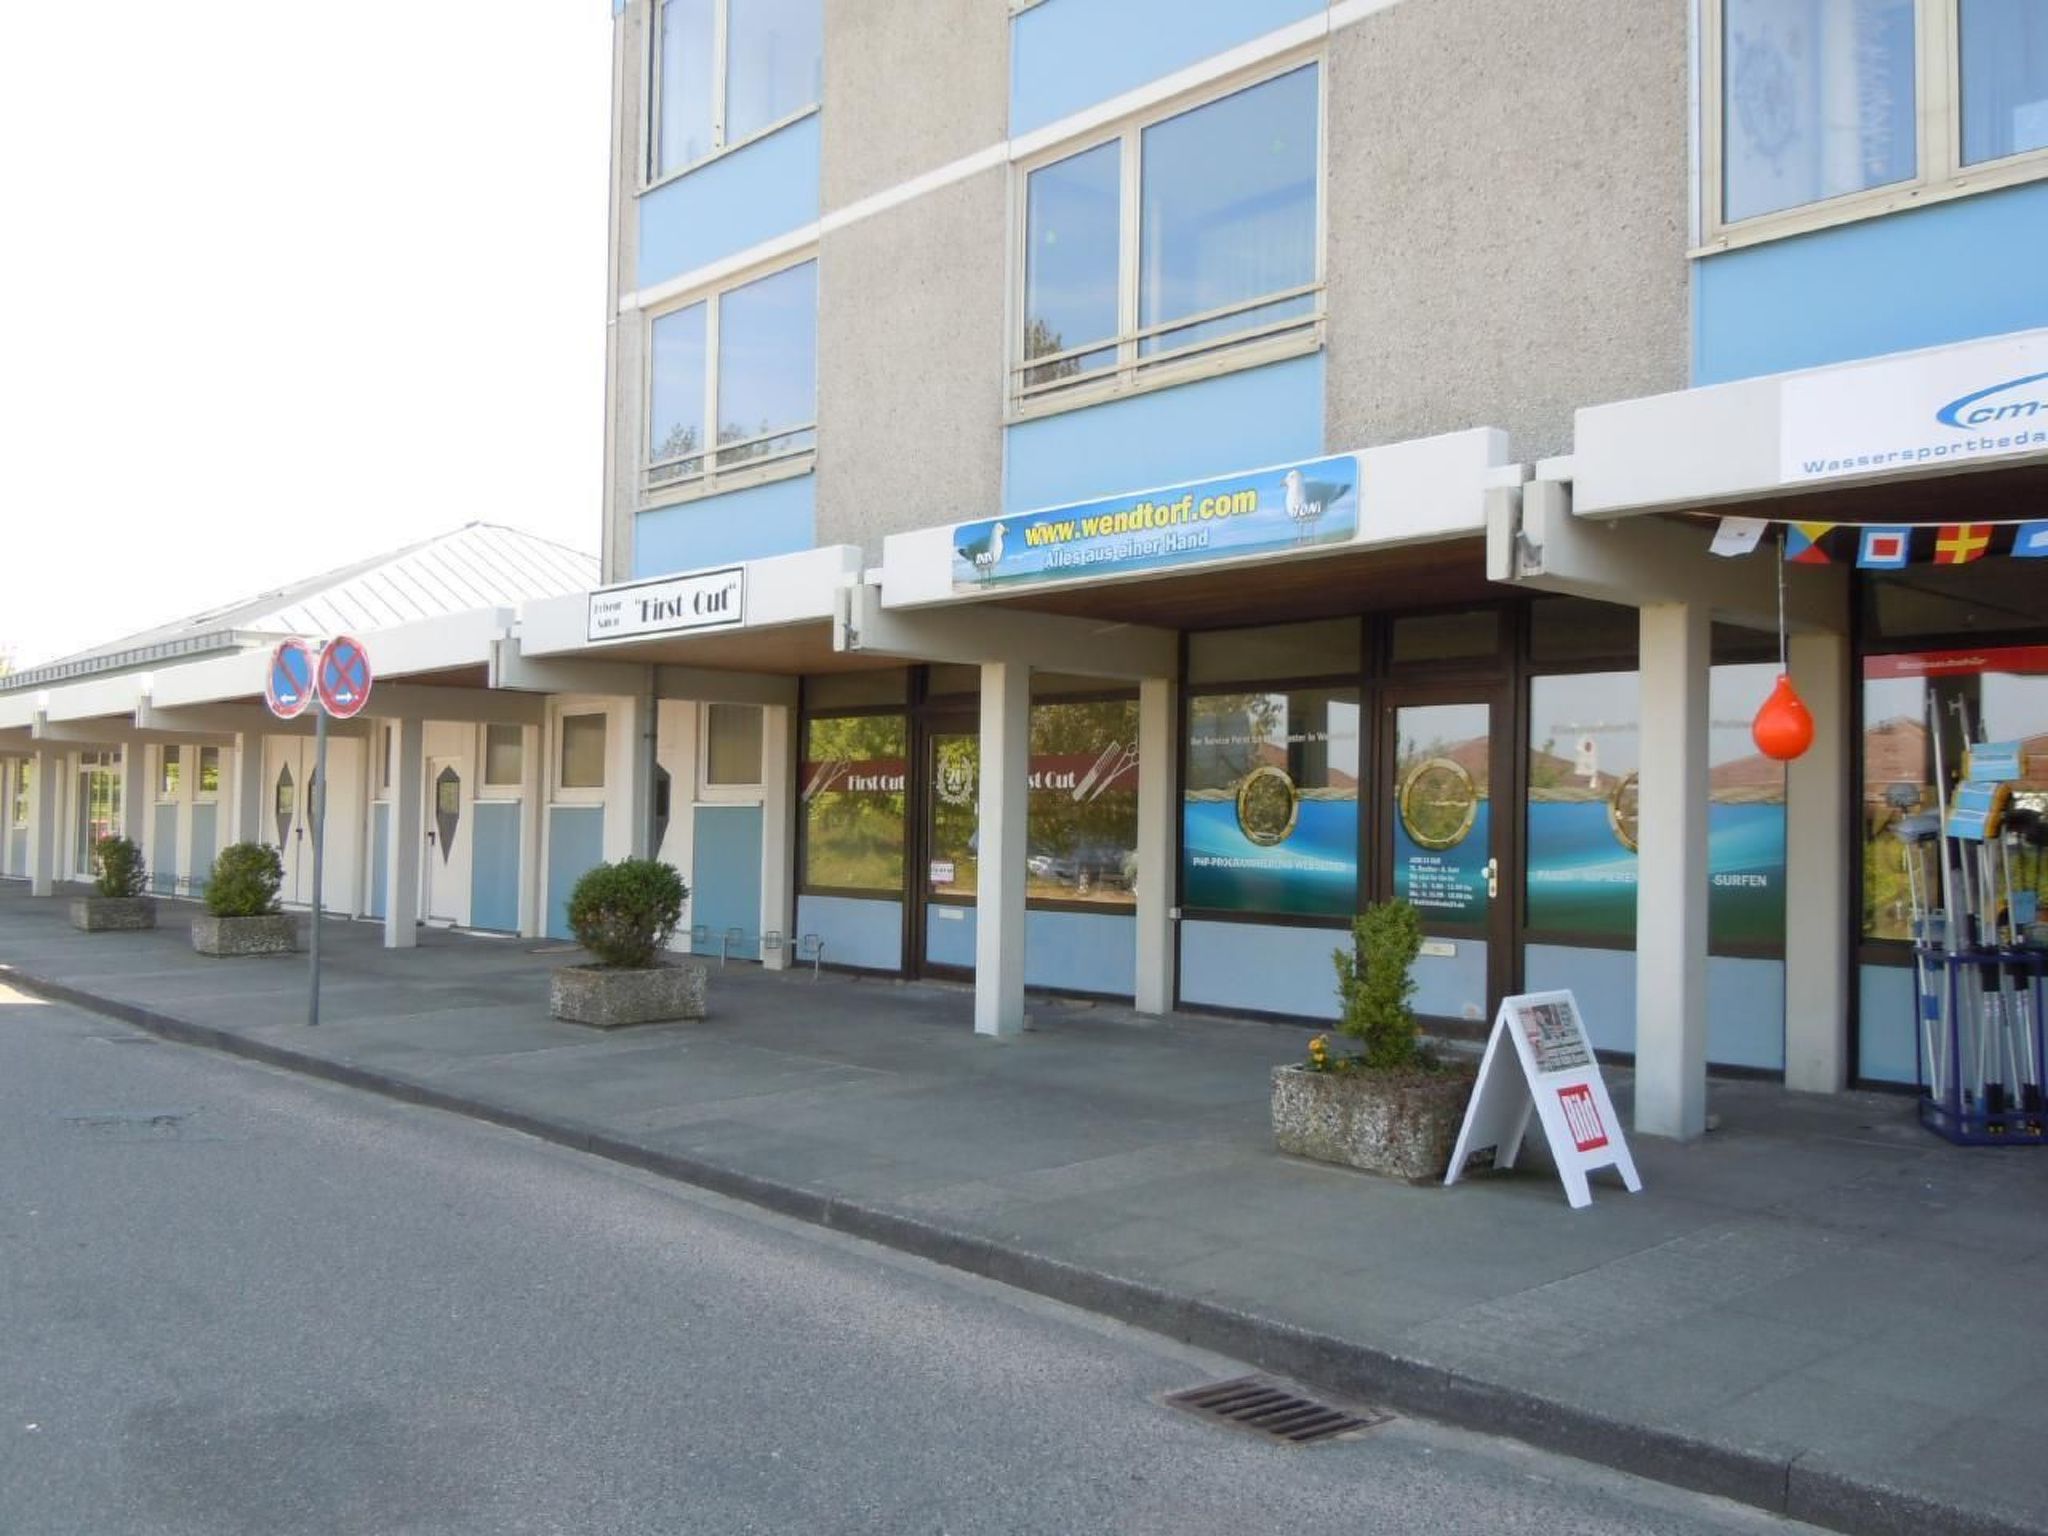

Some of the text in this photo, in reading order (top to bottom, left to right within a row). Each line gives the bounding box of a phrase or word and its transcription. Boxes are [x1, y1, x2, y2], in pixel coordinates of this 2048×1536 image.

[1024, 489, 1258, 547] www.wendtorf.com
[1046, 529, 1209, 568] Alles aus einer Hand
[848, 774, 905, 791] First Cut
[1044, 770, 1076, 789] Cut
